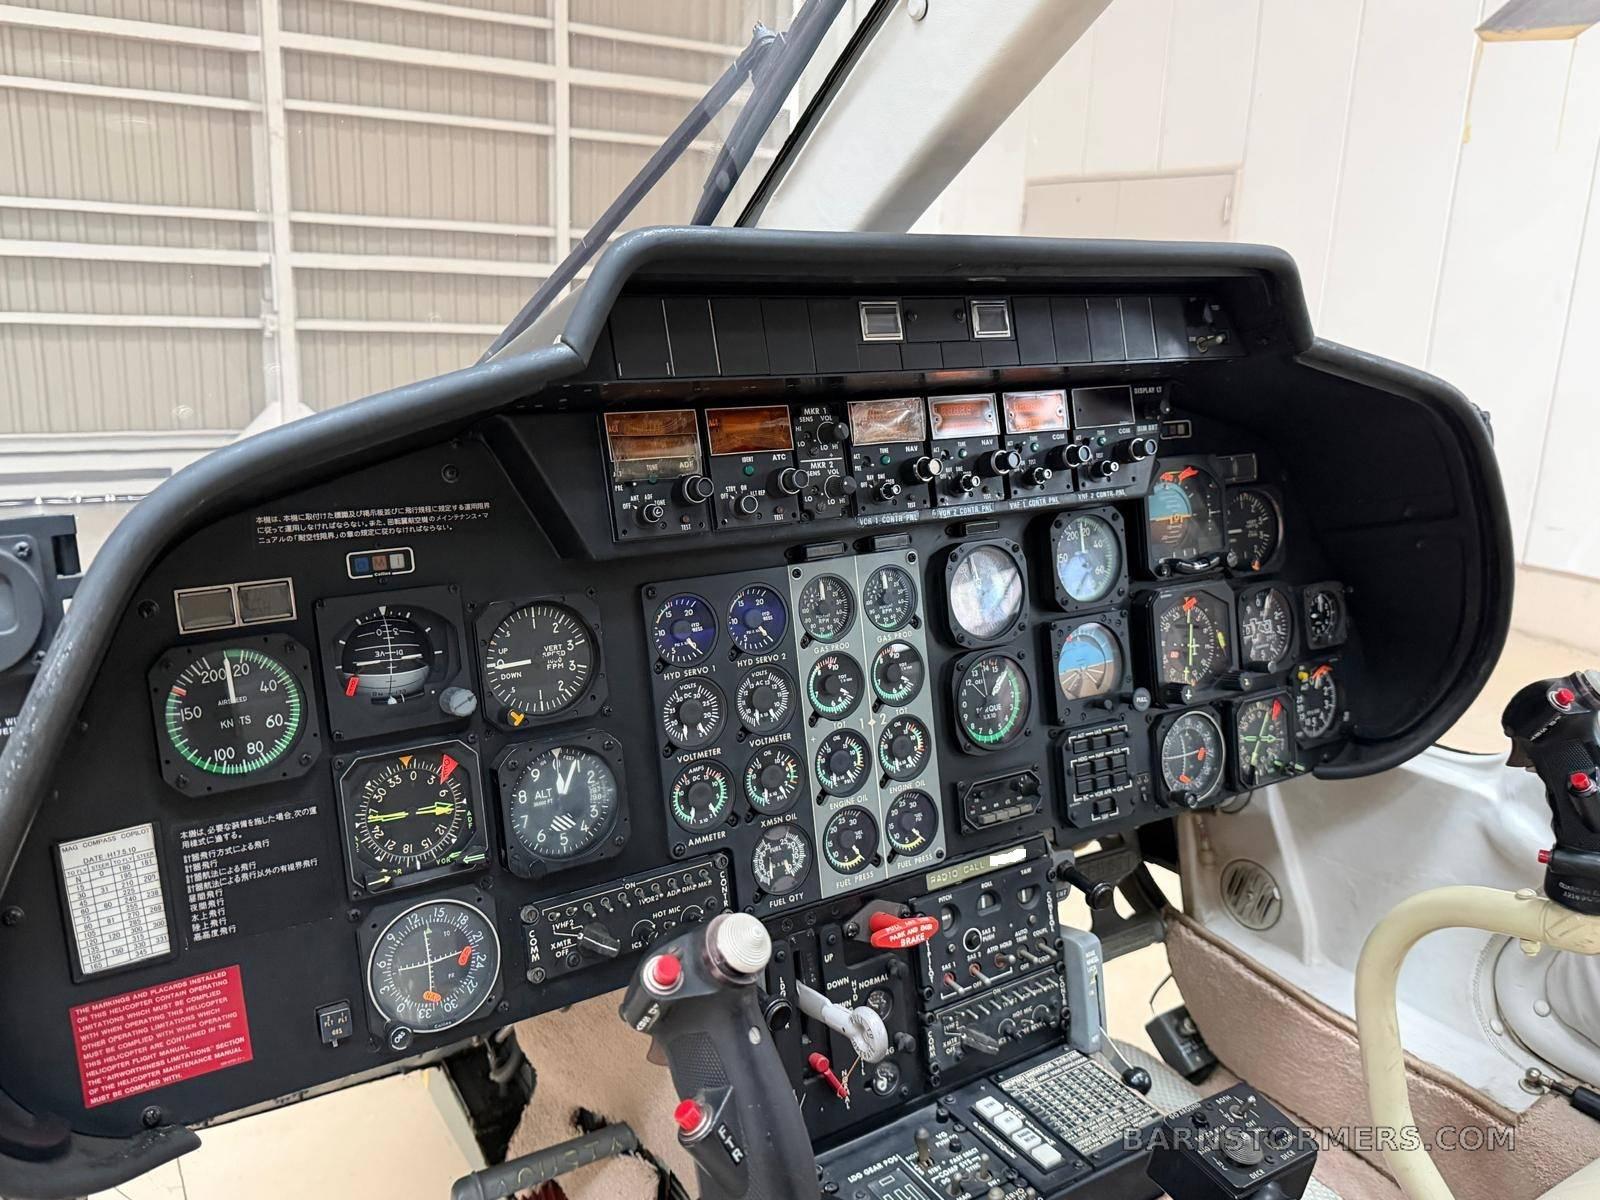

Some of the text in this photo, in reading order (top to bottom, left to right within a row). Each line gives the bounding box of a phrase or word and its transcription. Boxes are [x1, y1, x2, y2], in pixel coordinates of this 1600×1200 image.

[772, 453, 786, 461] ATC
[895, 631, 912, 639] PROD
[544, 644, 562, 652] VERT
[814, 643, 849, 654] GAS PROD
[737, 655, 778, 667] HYD SERVO
[201, 663, 250, 684] 200 20
[501, 672, 522, 680] DOWN
[664, 667, 708, 680] HYD SERVO
[260, 680, 277, 692] 40
[180, 706, 202, 721] 150
[880, 714, 886, 725] 2
[266, 714, 283, 728] 60
[749, 733, 791, 747] VOLTMETER
[214, 748, 235, 761] 100
[247, 741, 264, 754] 80
[677, 748, 721, 763] VOLTMETER
[535, 788, 552, 799] ALT
[889, 784, 913, 794] ENGINE
[830, 794, 868, 810] ENGINE OIL
[761, 813, 797, 827] XMSN OIL
[62, 828, 149, 853] MAG COMPASS COPILOT
[688, 831, 726, 847] AMMETER
[83, 855, 103, 864] DATE
[897, 854, 933, 869] FUEL PRESS
[836, 871, 874, 889] FUEL PRESS
[930, 862, 985, 884] RADIO CALL
[625, 882, 635, 890] ON
[769, 893, 804, 908] FUEL QTY
[939, 894, 952, 903] PITCH
[406, 913, 420, 925] 12
[434, 908, 445, 916] 15
[457, 913, 469, 924] 18
[653, 906, 681, 919] HOT MIC
[1015, 928, 1028, 937] AUTO
[529, 930, 540, 962] COMM
[551, 938, 572, 949] XMTR
[632, 941, 642, 949] ICS
[900, 933, 925, 947] BRAKE
[556, 949, 569, 958] OFF
[824, 953, 834, 963] UP
[827, 973, 889, 989] DOWN NORMAL
[92, 996, 130, 1010] MARKINGS
[151, 981, 188, 995] PLACARDS
[190, 971, 226, 984] INSTALLED
[90, 1011, 106, 1019] THIS
[110, 999, 152, 1015] HELICOPTER
[155, 990, 186, 1002] CONTAIN
[189, 980, 228, 993] OPERATING
[79, 1016, 124, 1032] LIMITATIONS
[127, 1009, 150, 1019] WHICH
[153, 1003, 172, 1012] MUST
[186, 990, 221, 1003] COMPLIED
[80, 997, 228, 1041] WITH WHEN OPERATING THIS HELICOPTER
[82, 1008, 220, 1051] OTHER OPERATING LIMITATIONS WHICH
[83, 1050, 103, 1060] MUST
[118, 1035, 153, 1049] COMPLIED
[156, 1030, 174, 1038] WITH
[176, 1023, 196, 1032] WHEN
[199, 1012, 237, 1026] OPERATING
[85, 1060, 101, 1068] THIS
[103, 1046, 147, 1063] HELICOPTER
[150, 1042, 163, 1050] ARE
[166, 1030, 206, 1046] CONTAINED
[86, 1061, 130, 1078] HELICOPTER
[132, 1053, 157, 1064] FLIGHT
[88, 1078, 102, 1086] THE
[216, 1036, 245, 1049] SECTION
[117, 1070, 161, 1087] HELICOPTER
[162, 1055, 212, 1073] MAINTENANCE
[214, 1047, 242, 1058] MANUAL
[90, 1094, 110, 1104] MUST
[125, 1080, 160, 1094] COMPLIED
[717, 1123, 744, 1163] FTR
[848, 1160, 883, 1183] LDG GEAR
